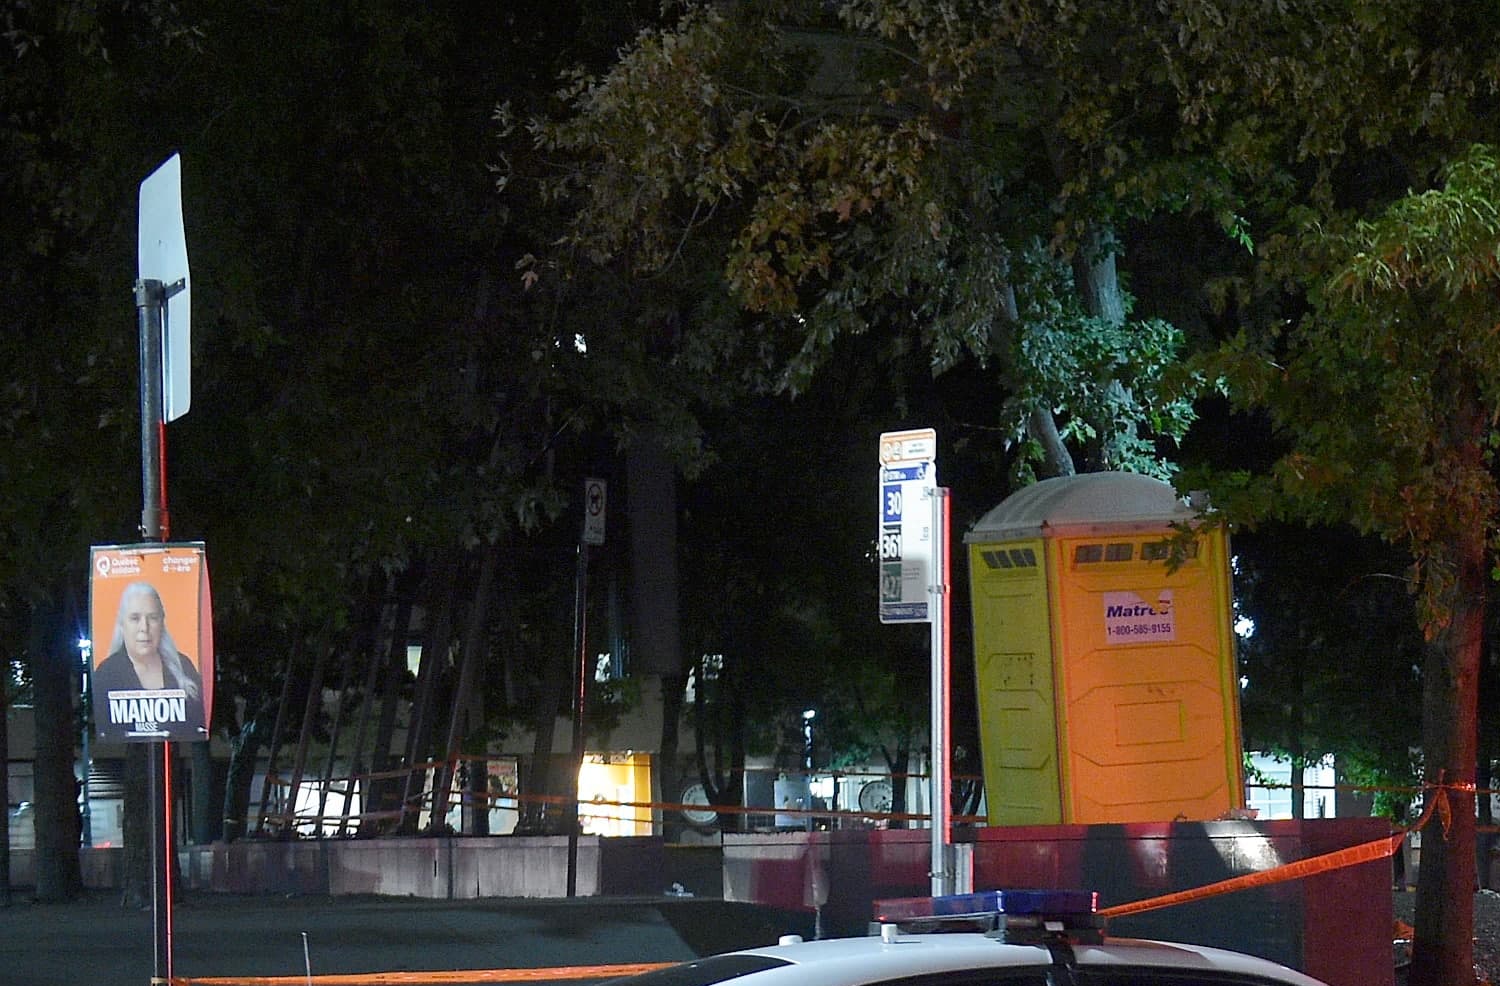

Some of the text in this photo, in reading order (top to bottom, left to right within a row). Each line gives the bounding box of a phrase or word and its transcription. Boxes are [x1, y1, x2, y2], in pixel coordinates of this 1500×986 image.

[887, 491, 902, 516] 30
[882, 534, 902, 558] 361
[109, 698, 186, 723] MANON
